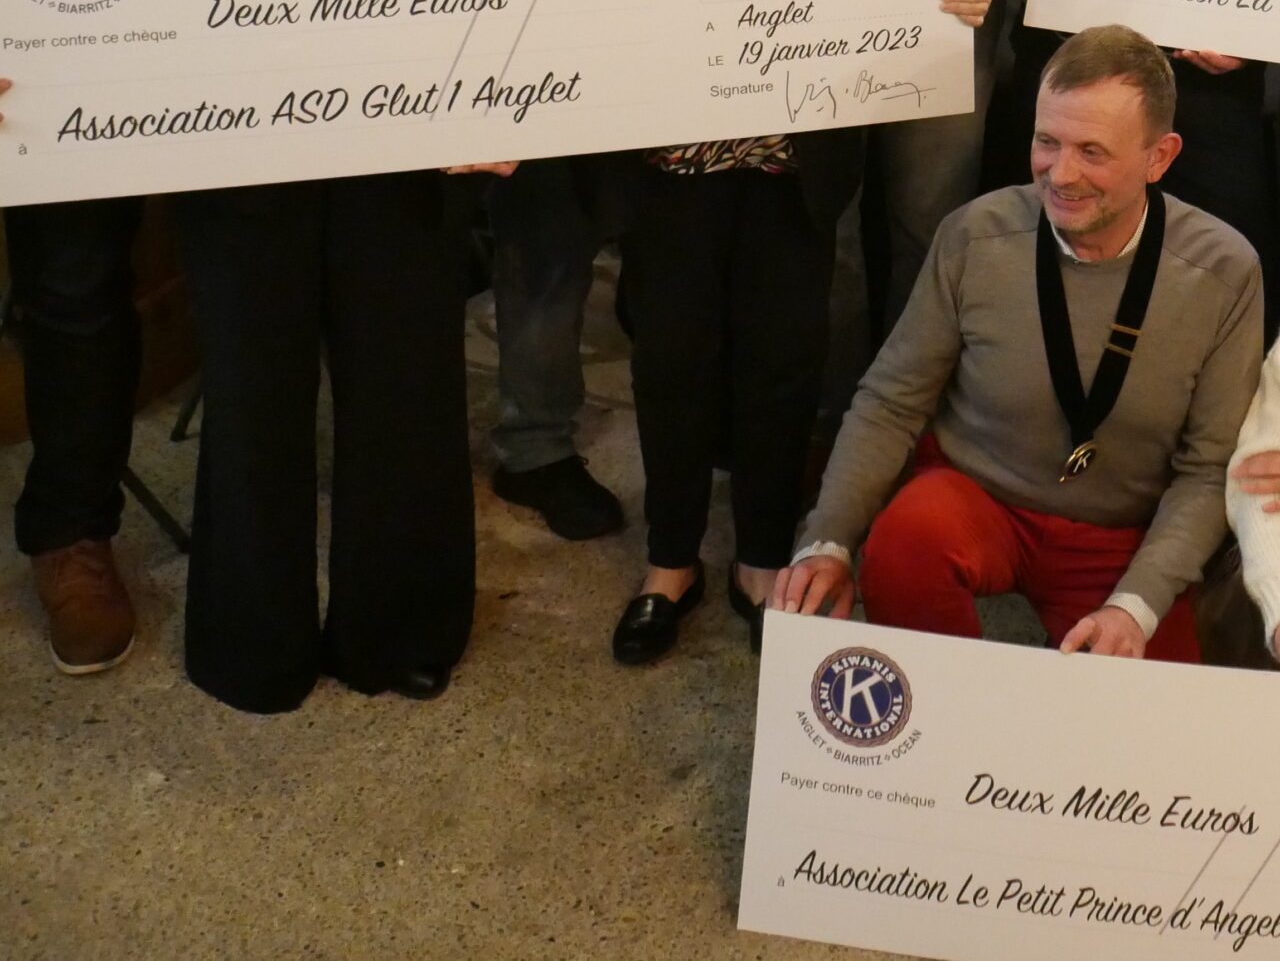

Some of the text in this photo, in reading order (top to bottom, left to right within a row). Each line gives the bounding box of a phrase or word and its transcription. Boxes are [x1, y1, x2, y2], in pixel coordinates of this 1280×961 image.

[3, 37, 46, 52] Payer
[51, 34, 97, 48] contre
[102, 33, 119, 44] ce
[705, 0, 814, 38] A Anglet
[708, 26, 922, 76] LE 19 janvier 2023
[57, 102, 260, 143] Association
[271, 87, 349, 126] ASD
[361, 83, 439, 116] Glut
[471, 71, 582, 124] Anglet
[710, 82, 774, 99] Signature
[831, 655, 896, 683] KIWANIS
[819, 682, 903, 738] INTERNATIONAL
[841, 668, 883, 723] K
[796, 710, 922, 766] ANGLET BIARRITZ OCEAN
[780, 772, 818, 789] Payer
[823, 781, 863, 797] contre
[867, 789, 882, 800] ce
[965, 773, 1259, 835] Deux Mille Euros
[794, 849, 949, 904] Association
[955, 874, 990, 907] Le
[996, 879, 1063, 918] Petit
[1069, 887, 1163, 929] Prince
